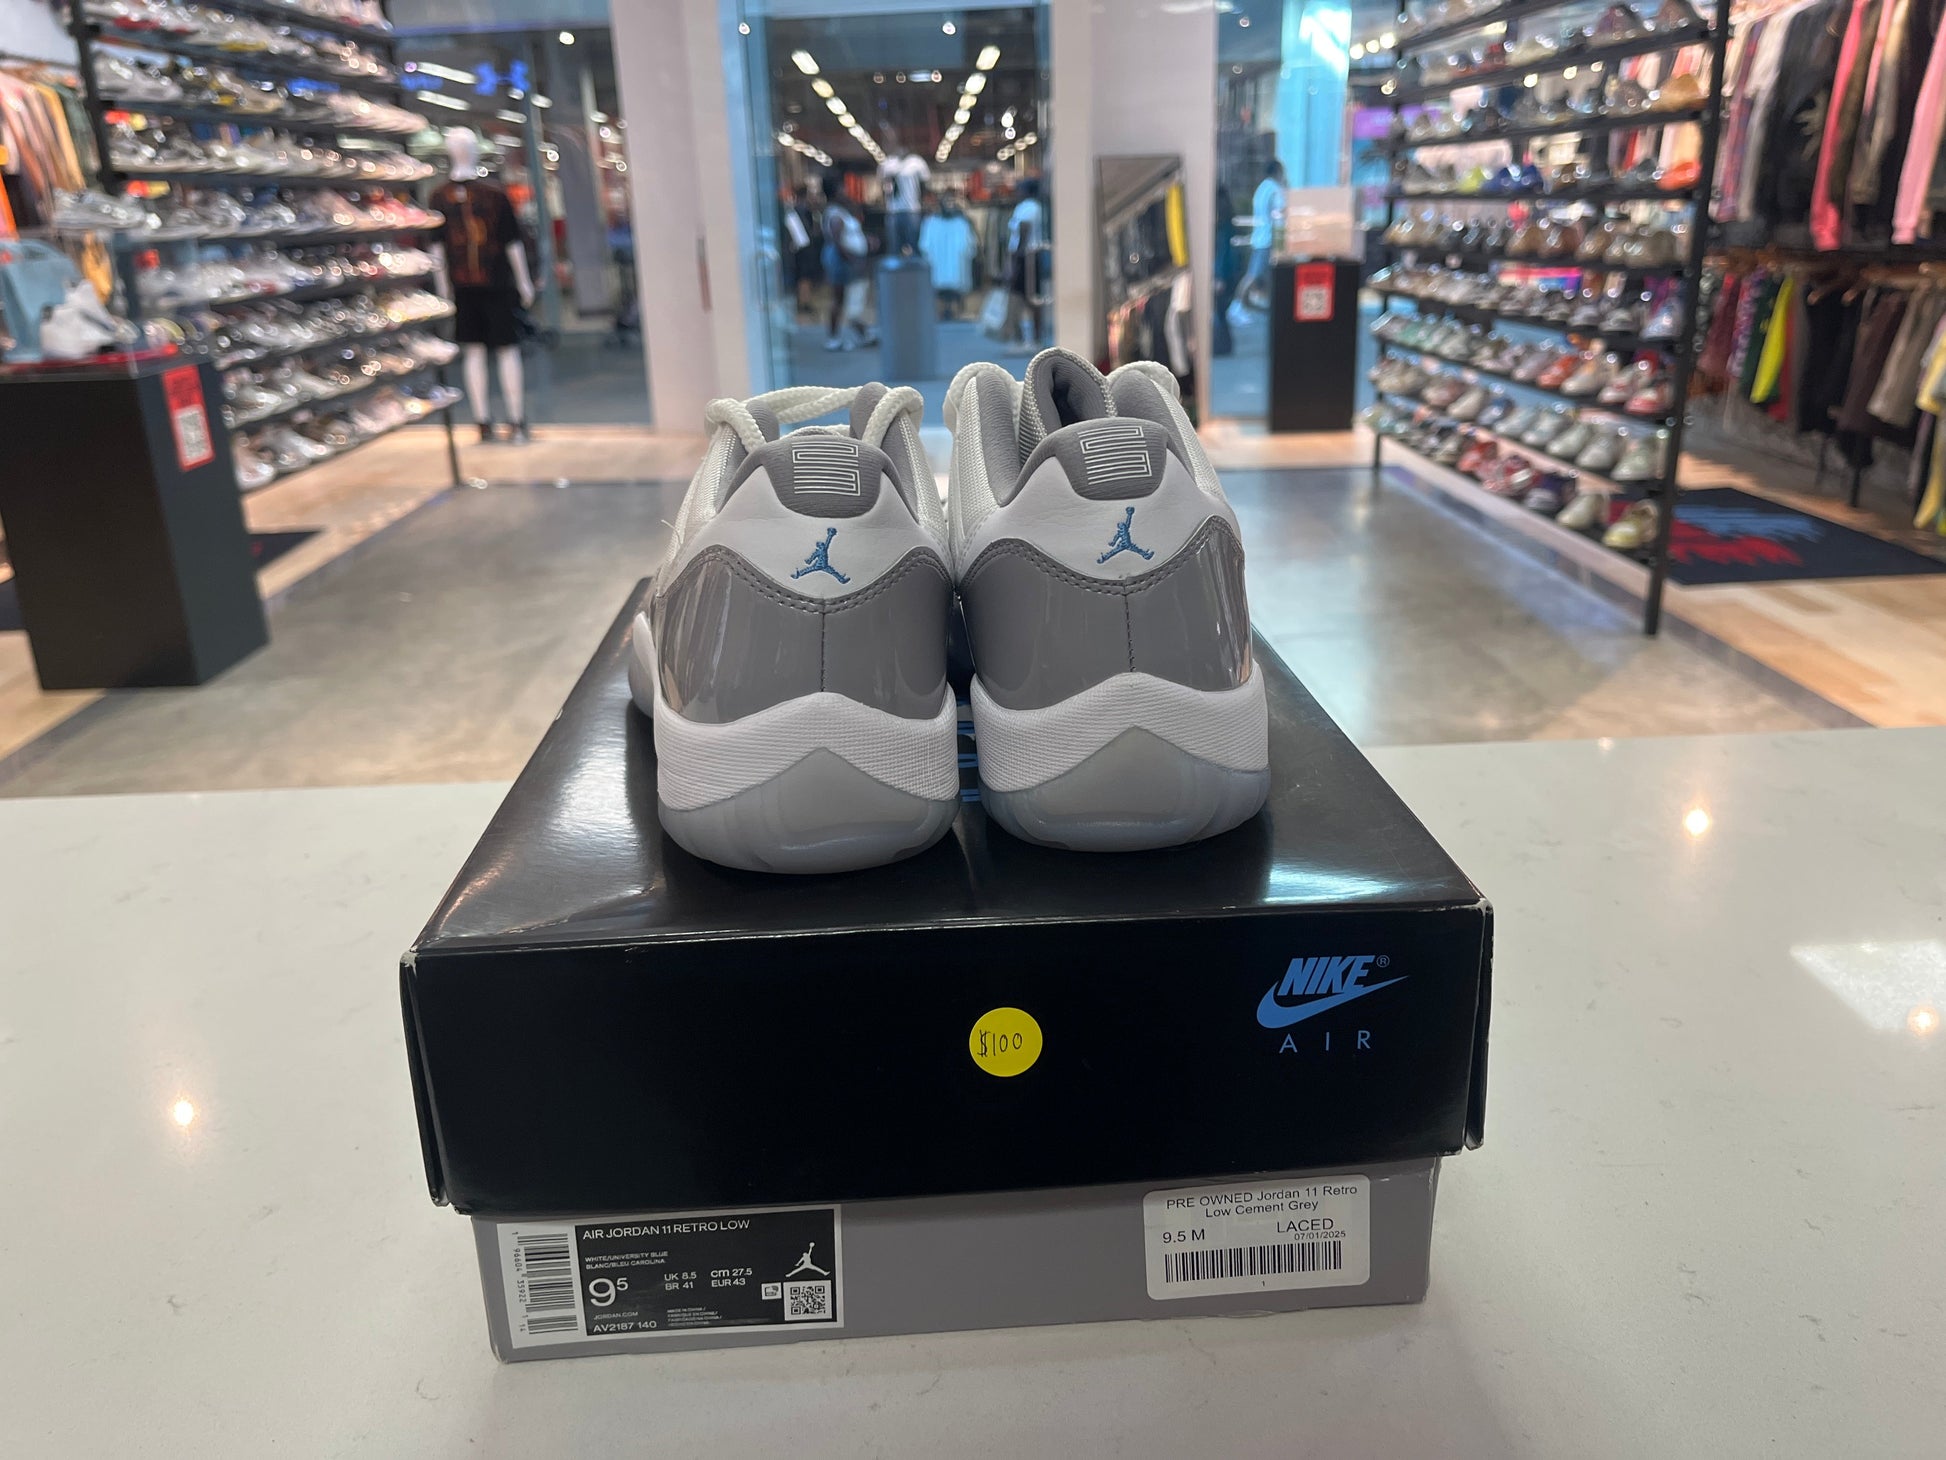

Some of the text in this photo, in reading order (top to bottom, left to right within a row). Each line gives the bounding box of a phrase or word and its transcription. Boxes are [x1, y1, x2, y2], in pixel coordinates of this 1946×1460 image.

[1277, 955, 1376, 996] NIKE
[977, 1029, 1023, 1057] $100
[1279, 1030, 1371, 1054] AIR
[1166, 1185, 1358, 1209] PRE OWNED Jordan 11 Retro
[1205, 1200, 1319, 1218] Low Cement Grey
[583, 1219, 750, 1240] AIR JORDAN 11 RETRO LOW
[1276, 1218, 1334, 1233] LACED
[1162, 1229, 1206, 1243] 9.5 M
[1294, 1230, 1346, 1240] 07/01/2025
[631, 1258, 666, 1267] CAROLINA
[664, 1271, 697, 1281] UK 8.5
[710, 1268, 752, 1278] cm 27.5
[665, 1281, 694, 1291] BR 41
[711, 1277, 746, 1288] EUR 43
[593, 1322, 635, 1333] AV2187
[638, 1320, 657, 1329] 140
